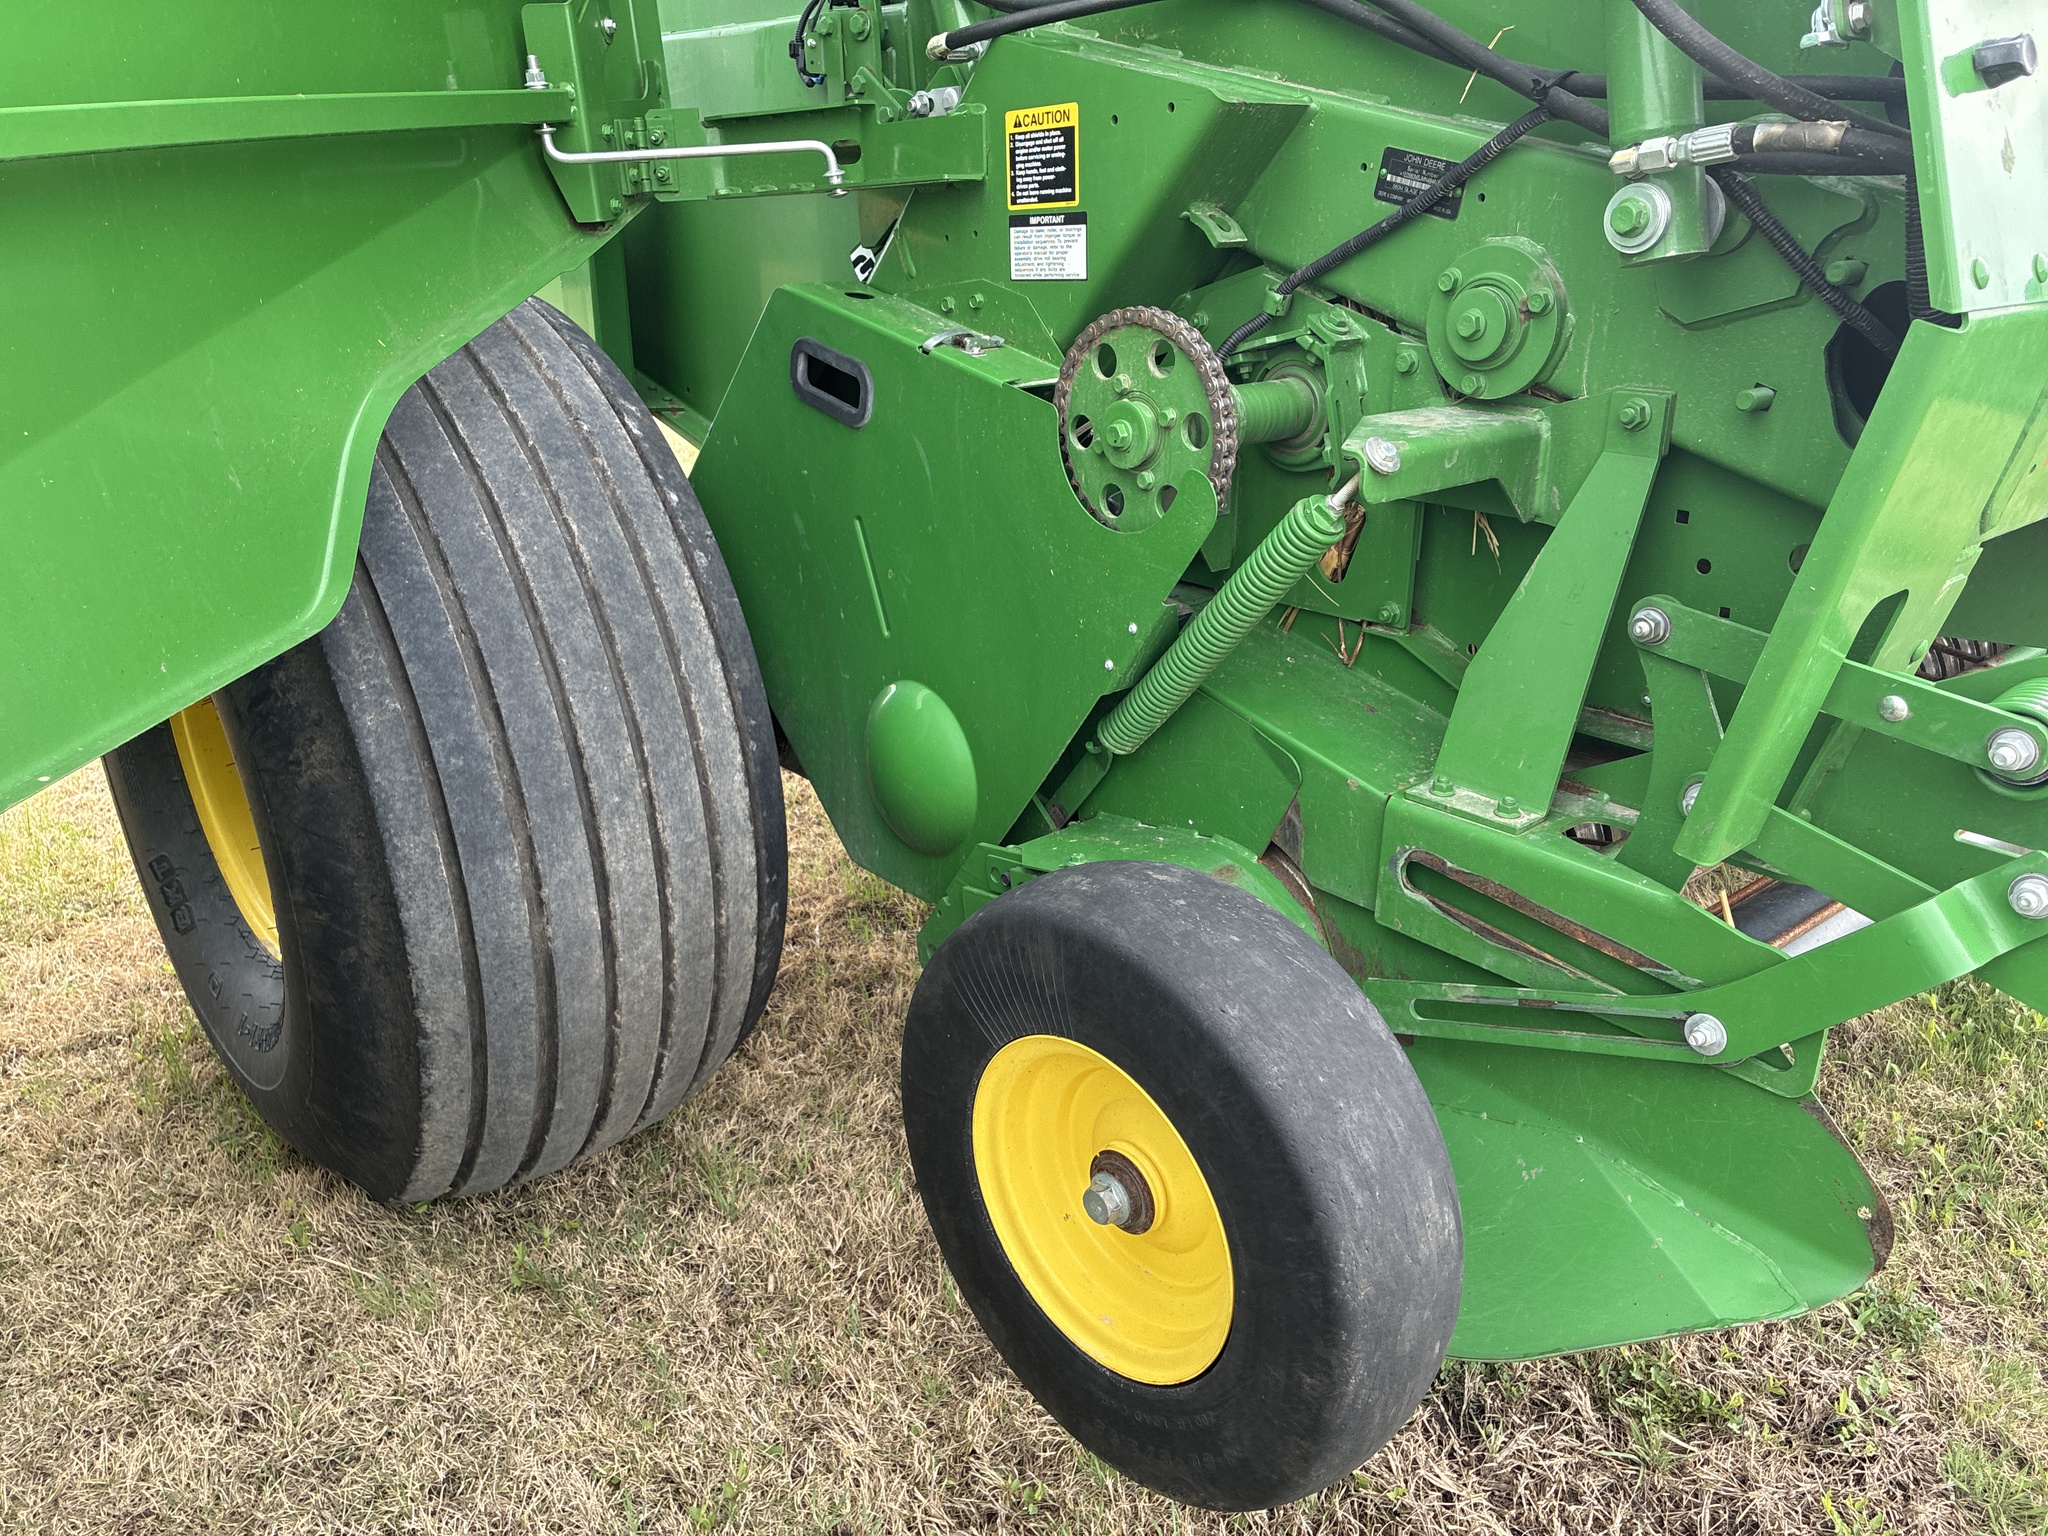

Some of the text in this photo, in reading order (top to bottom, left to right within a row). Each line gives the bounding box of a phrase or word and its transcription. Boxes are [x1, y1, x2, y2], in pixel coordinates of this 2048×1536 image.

[1023, 109, 1070, 127] CAUTION
[1404, 154, 1446, 171] JOHN DEERE
[1030, 215, 1065, 225] IMPORTANT
